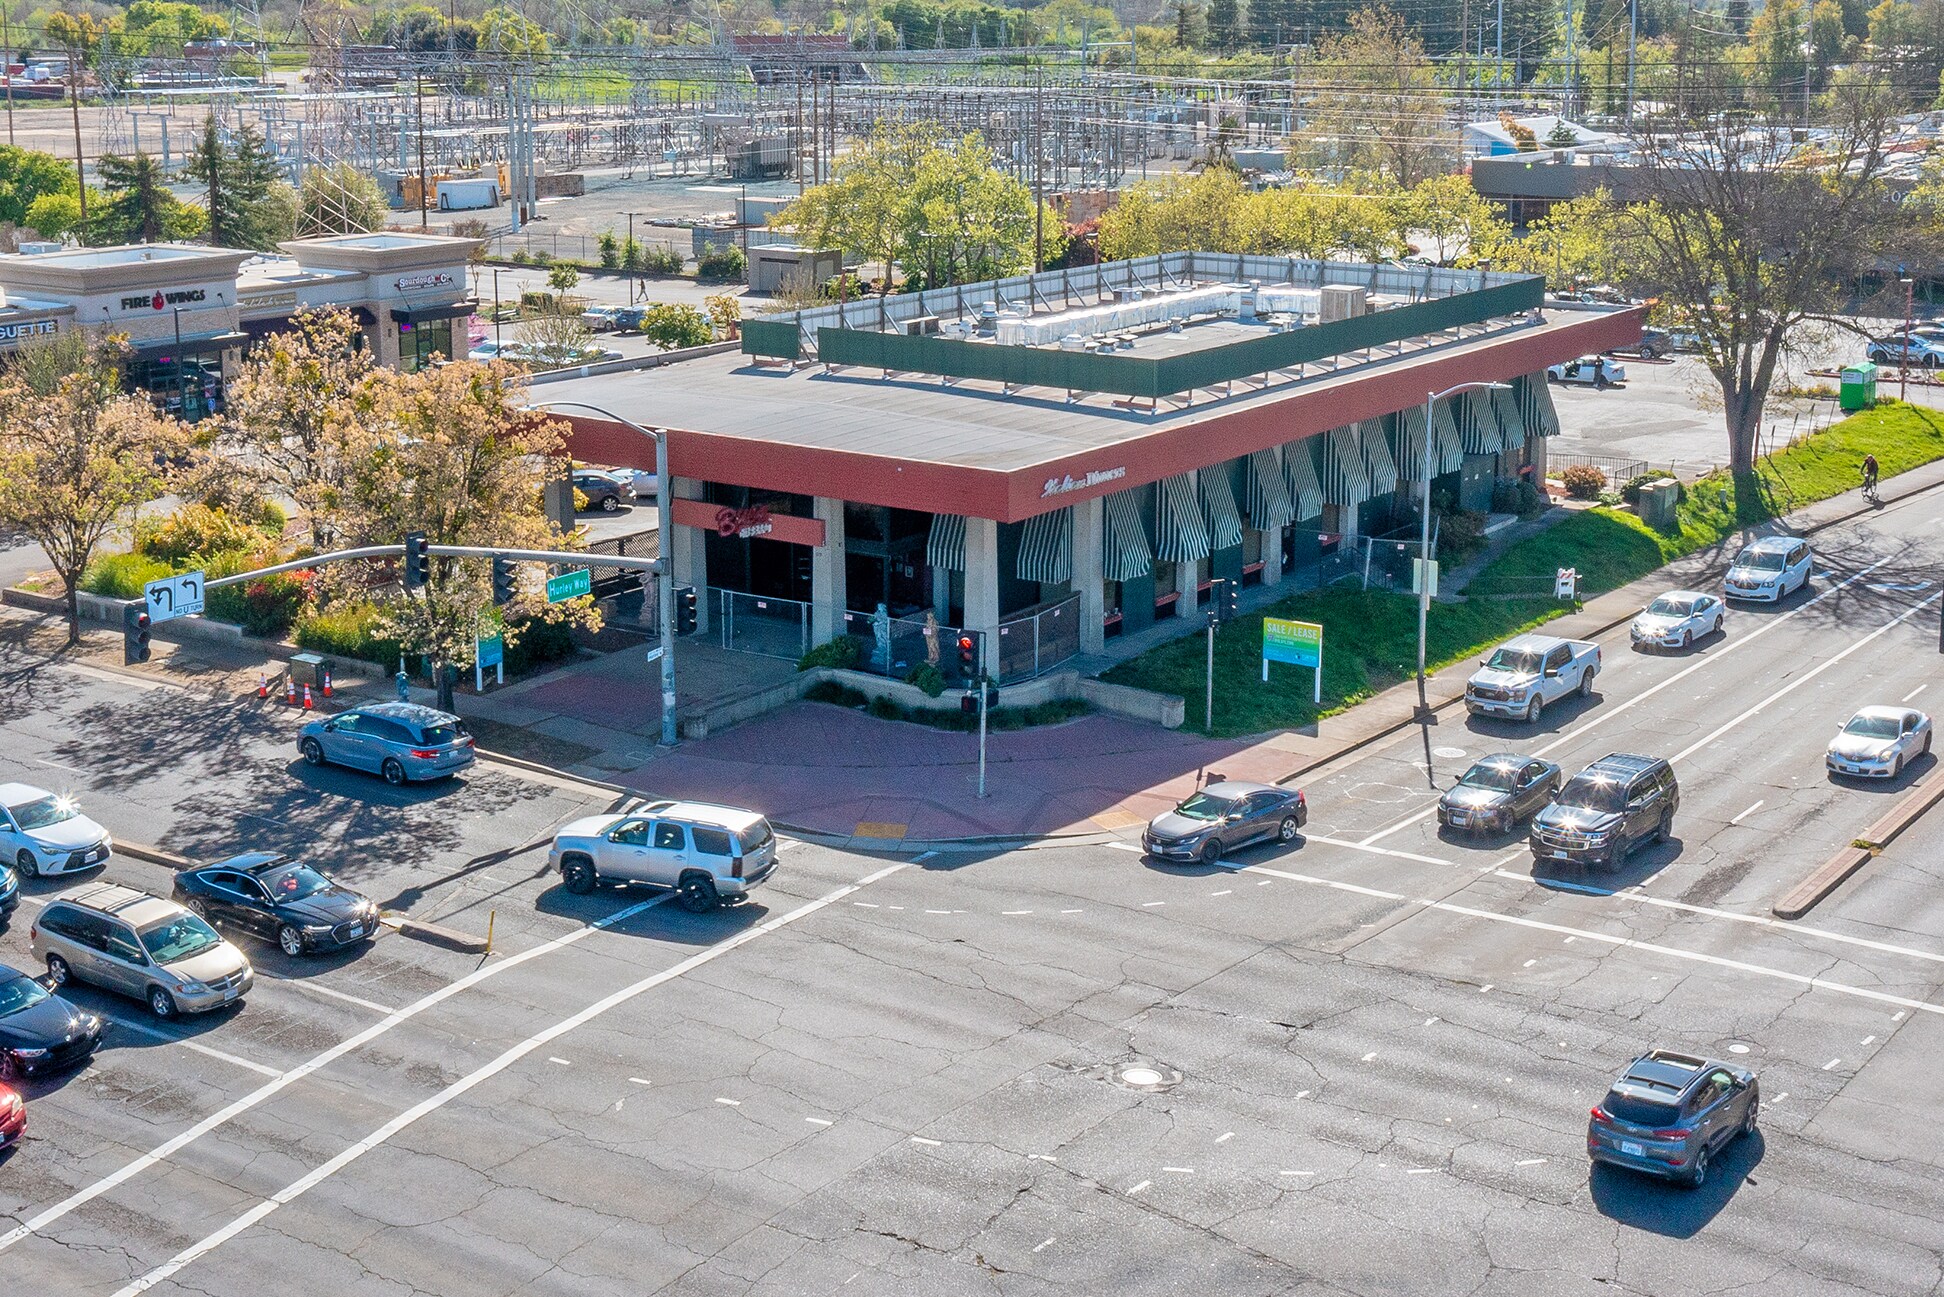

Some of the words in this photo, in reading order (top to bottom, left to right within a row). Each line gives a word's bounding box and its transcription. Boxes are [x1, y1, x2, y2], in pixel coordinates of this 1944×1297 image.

[121, 296, 151, 310] FIRE
[165, 289, 206, 304] WINGS
[549, 582, 573, 597] Hurley
[573, 578, 588, 590] Way
[183, 606, 189, 614] U
[190, 604, 202, 612] TURN
[1267, 622, 1287, 635] SALE
[1293, 626, 1318, 640] LEASE
